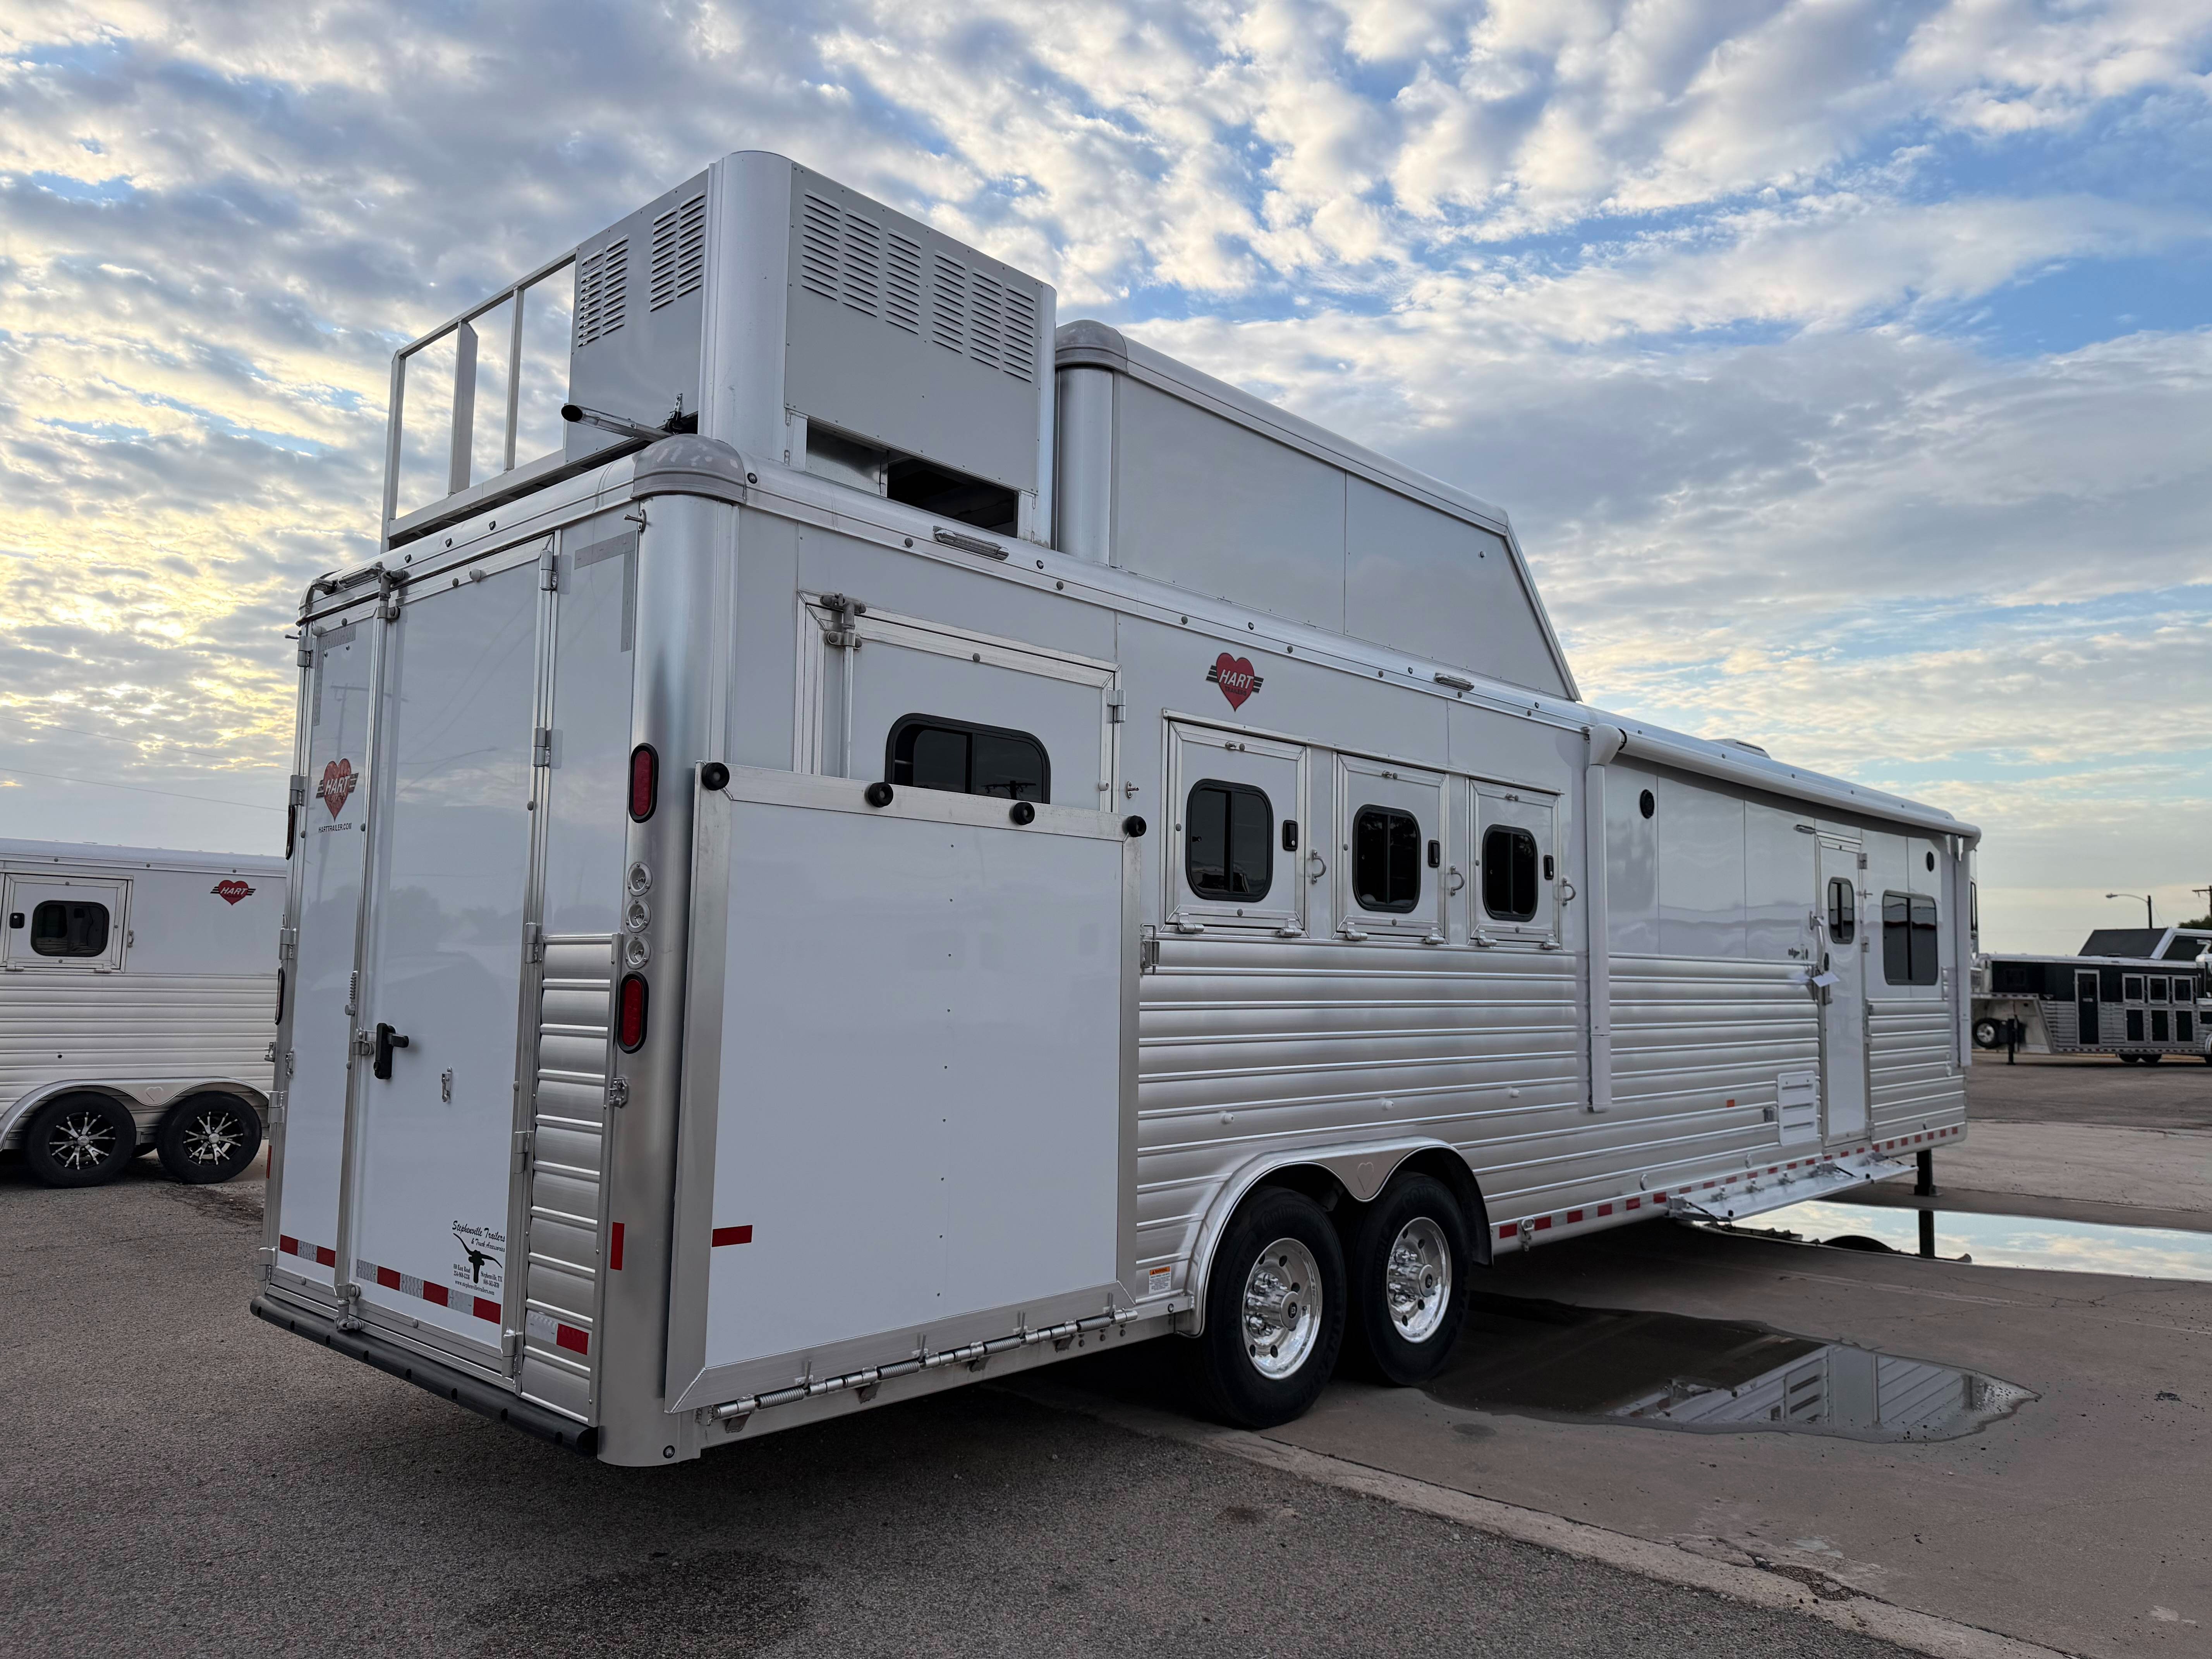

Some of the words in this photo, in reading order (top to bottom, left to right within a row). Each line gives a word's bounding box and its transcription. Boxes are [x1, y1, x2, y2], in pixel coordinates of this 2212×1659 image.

[1219, 669, 1254, 689] HART
[1224, 686, 1247, 696] TRAILERS
[325, 775, 350, 795] HART
[452, 1220, 483, 1237] Stephenville
[484, 1228, 505, 1242] Trailers
